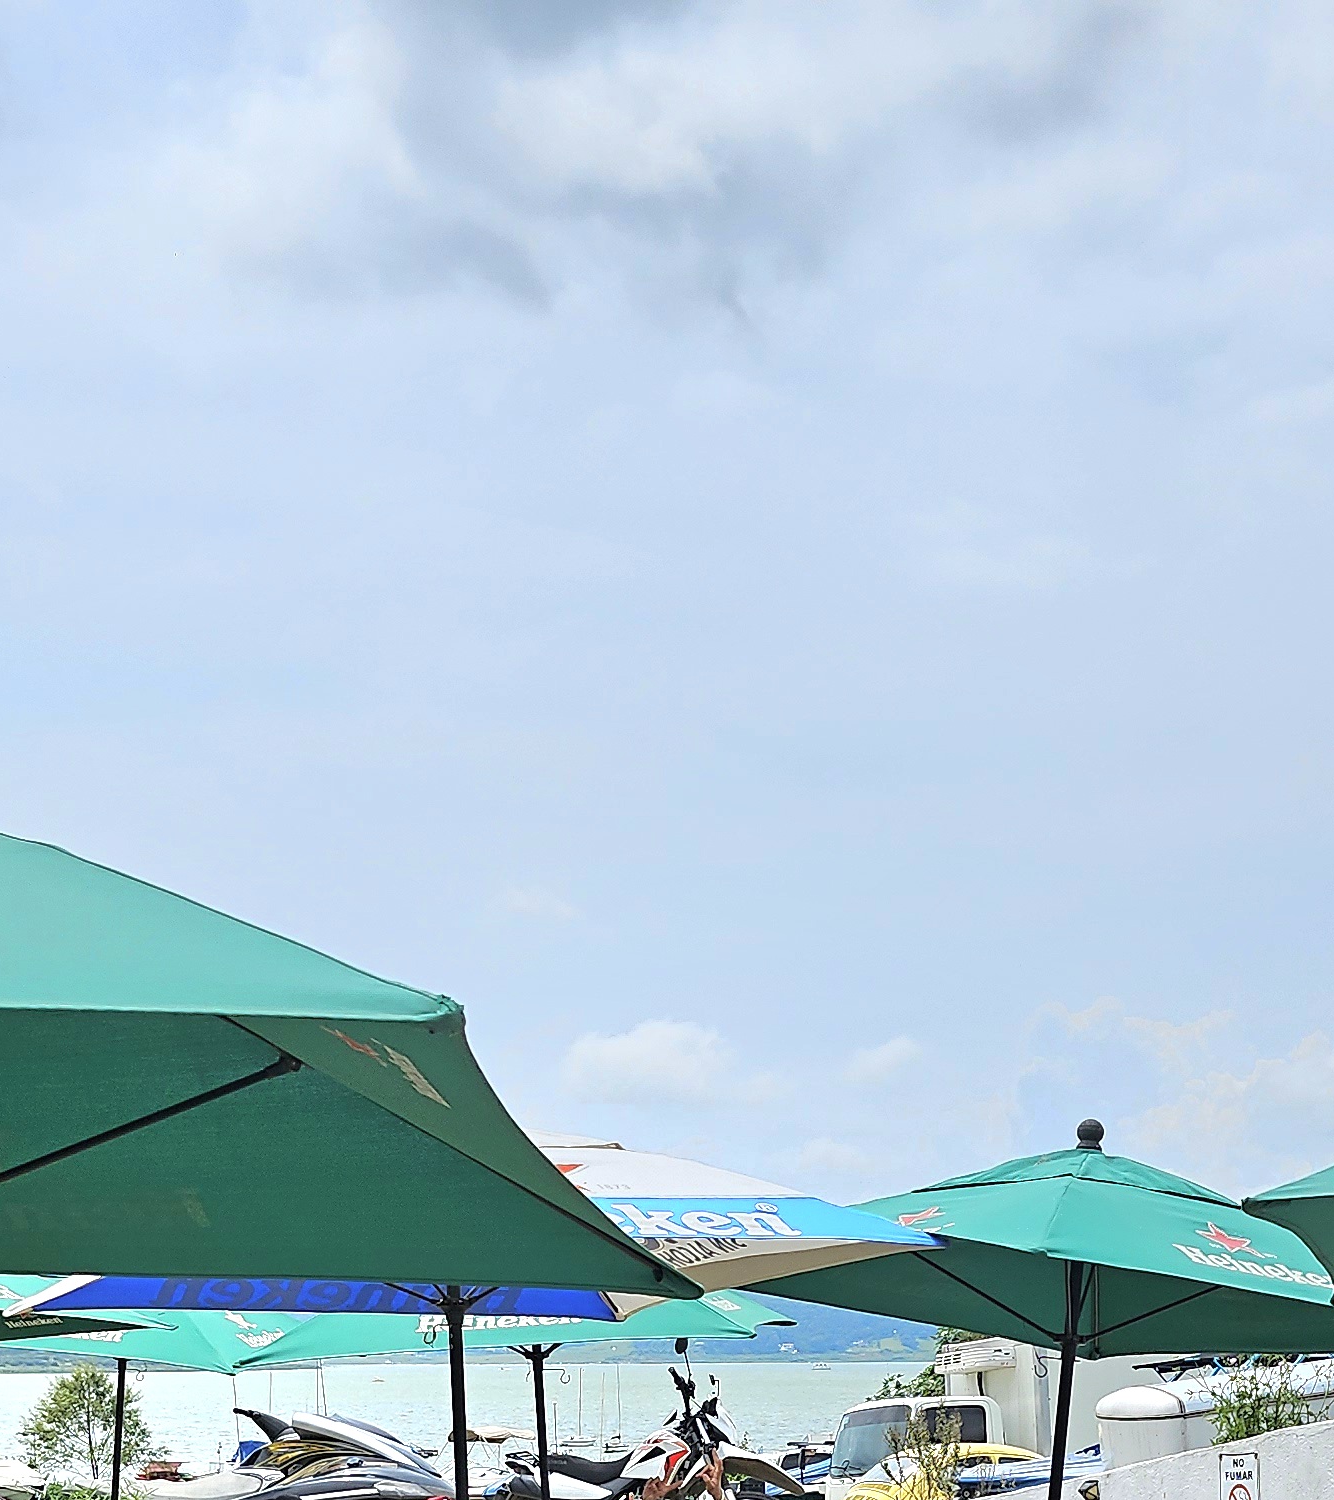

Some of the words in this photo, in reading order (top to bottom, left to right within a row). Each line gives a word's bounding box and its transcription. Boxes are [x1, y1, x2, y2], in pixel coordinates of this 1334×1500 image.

[4, 1316, 64, 1329] Heineken
[1232, 1458, 1245, 1468] NO
[1224, 1470, 1254, 1481] FUMAR
